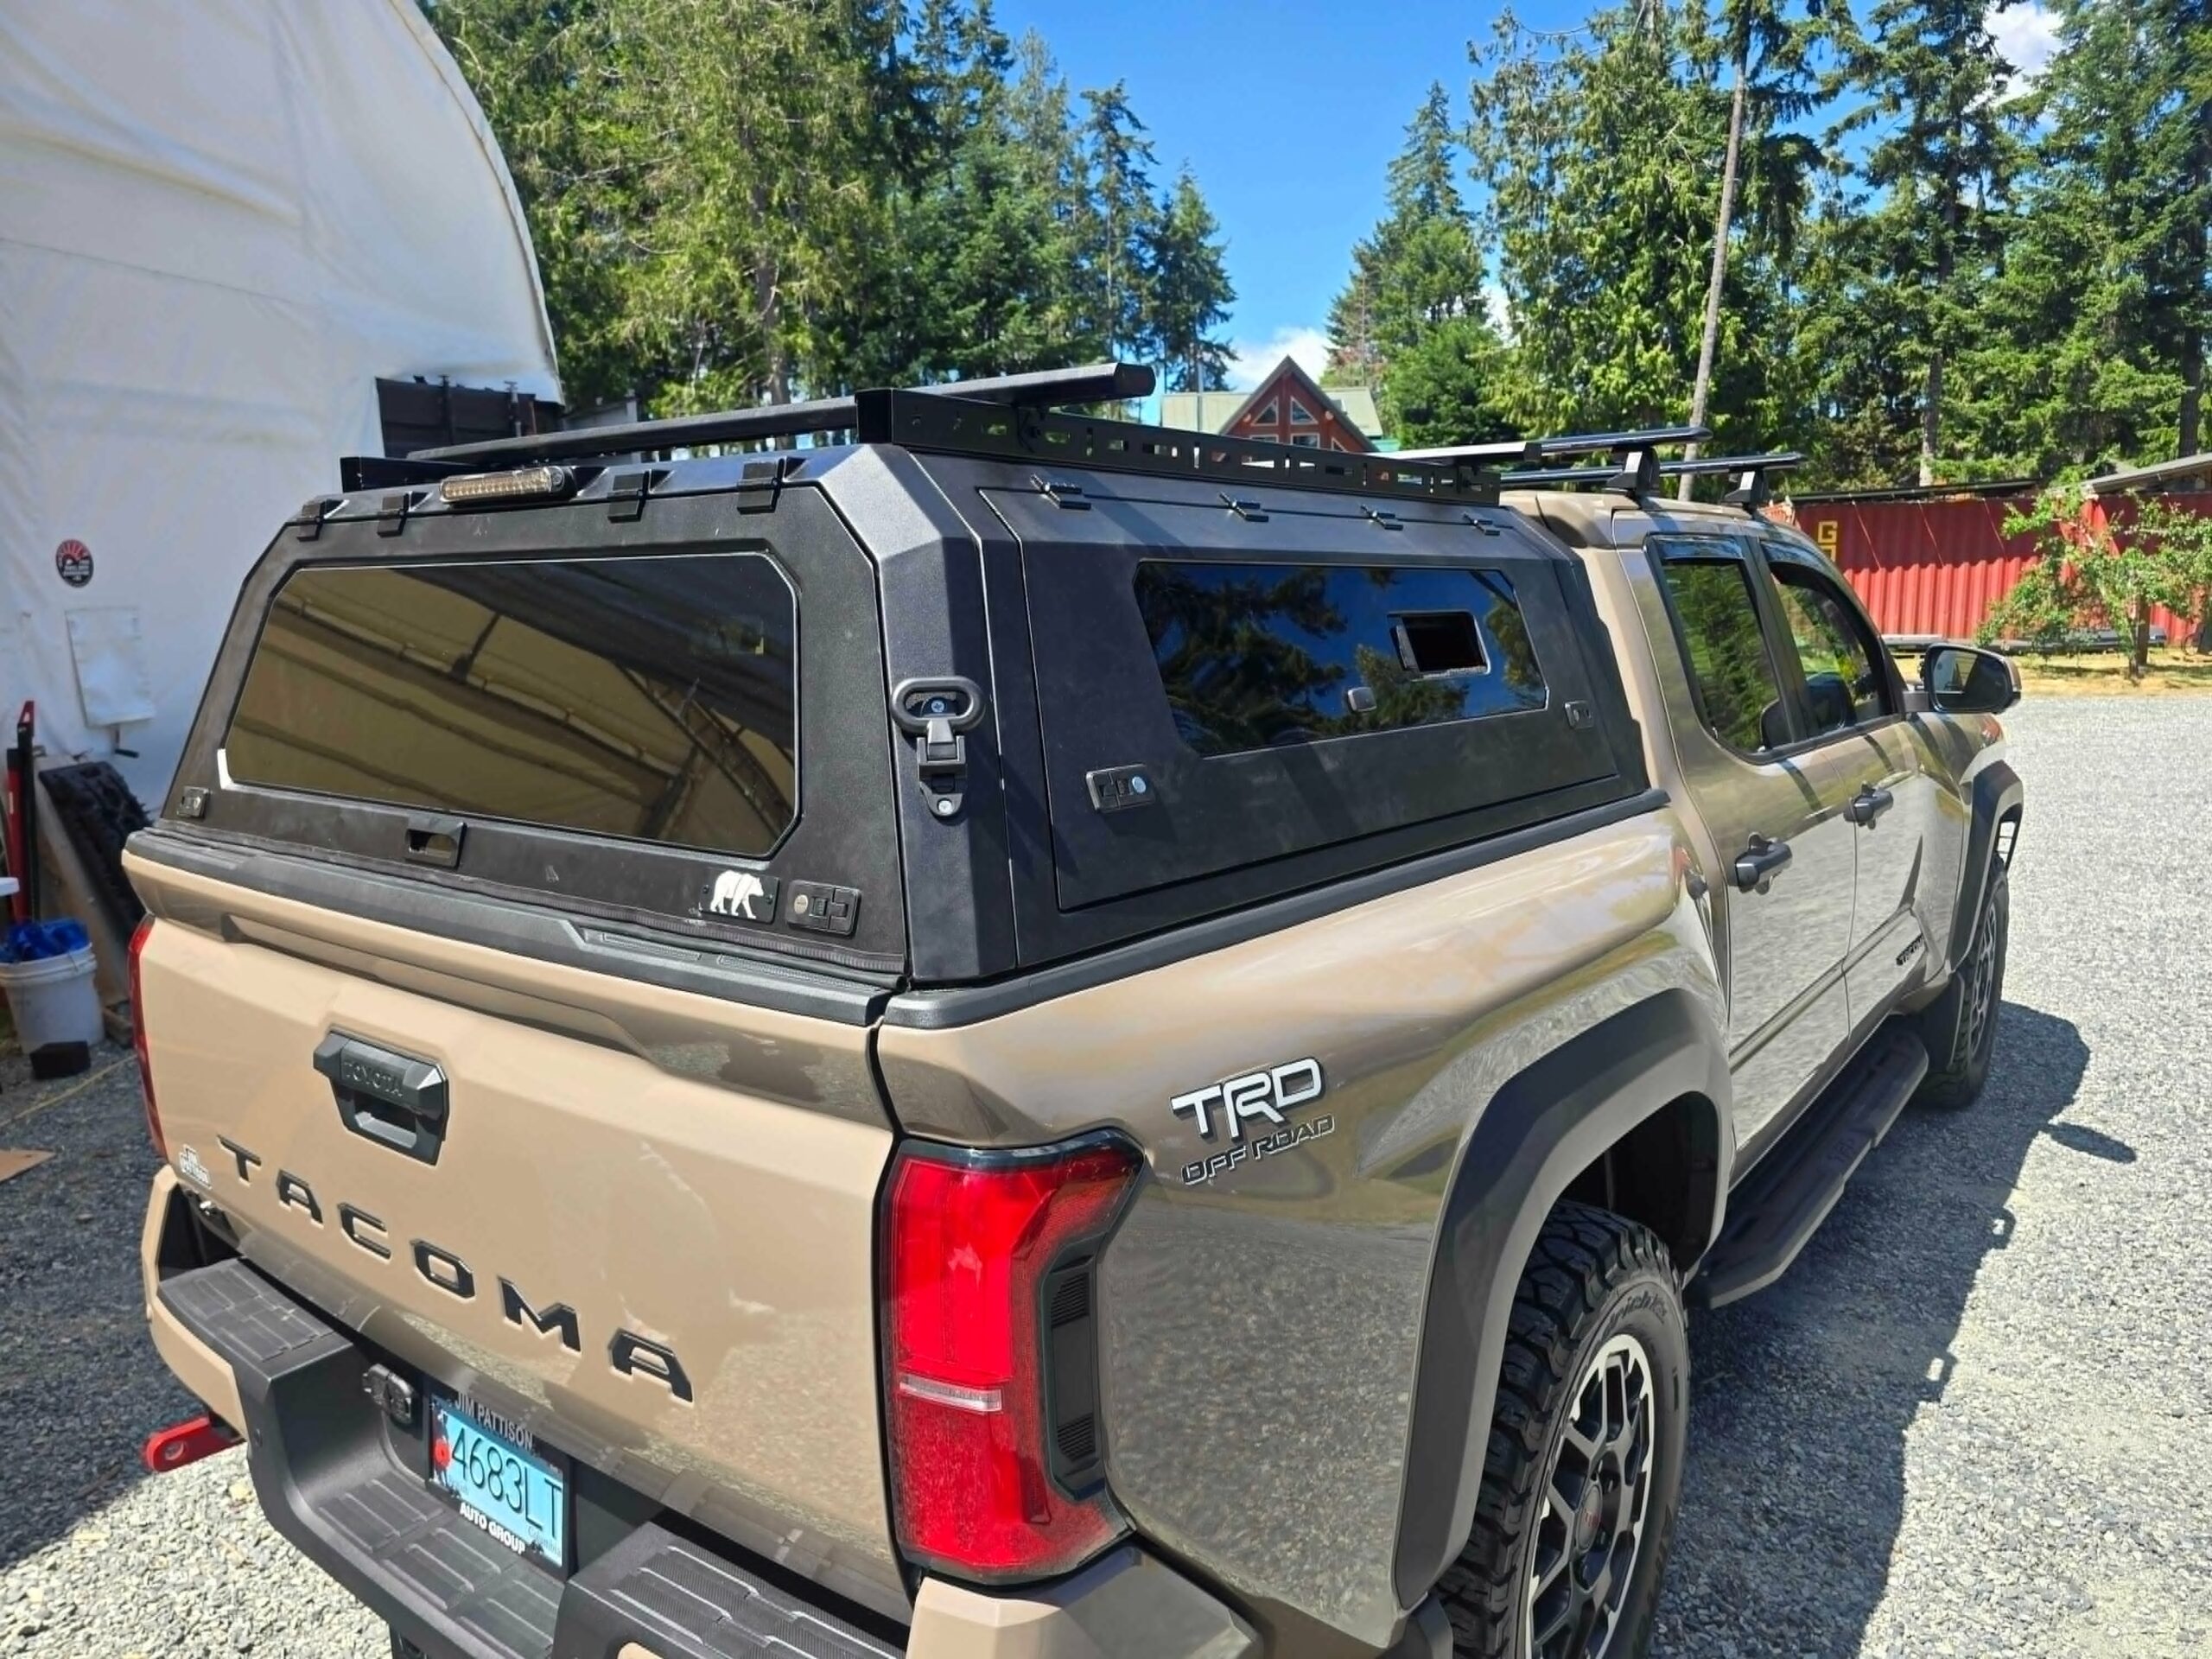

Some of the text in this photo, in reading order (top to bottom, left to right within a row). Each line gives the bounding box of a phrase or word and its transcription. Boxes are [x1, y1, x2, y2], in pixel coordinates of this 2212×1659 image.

[1170, 1058, 1323, 1140] TRD
[1180, 1114, 1335, 1185] OFF ROAD
[216, 1134, 694, 1403] TACOMA
[454, 1393, 533, 1452] JIM PATTISON
[451, 1427, 563, 1540] 4683LT
[459, 1502, 526, 1555] AUTO GROUP
